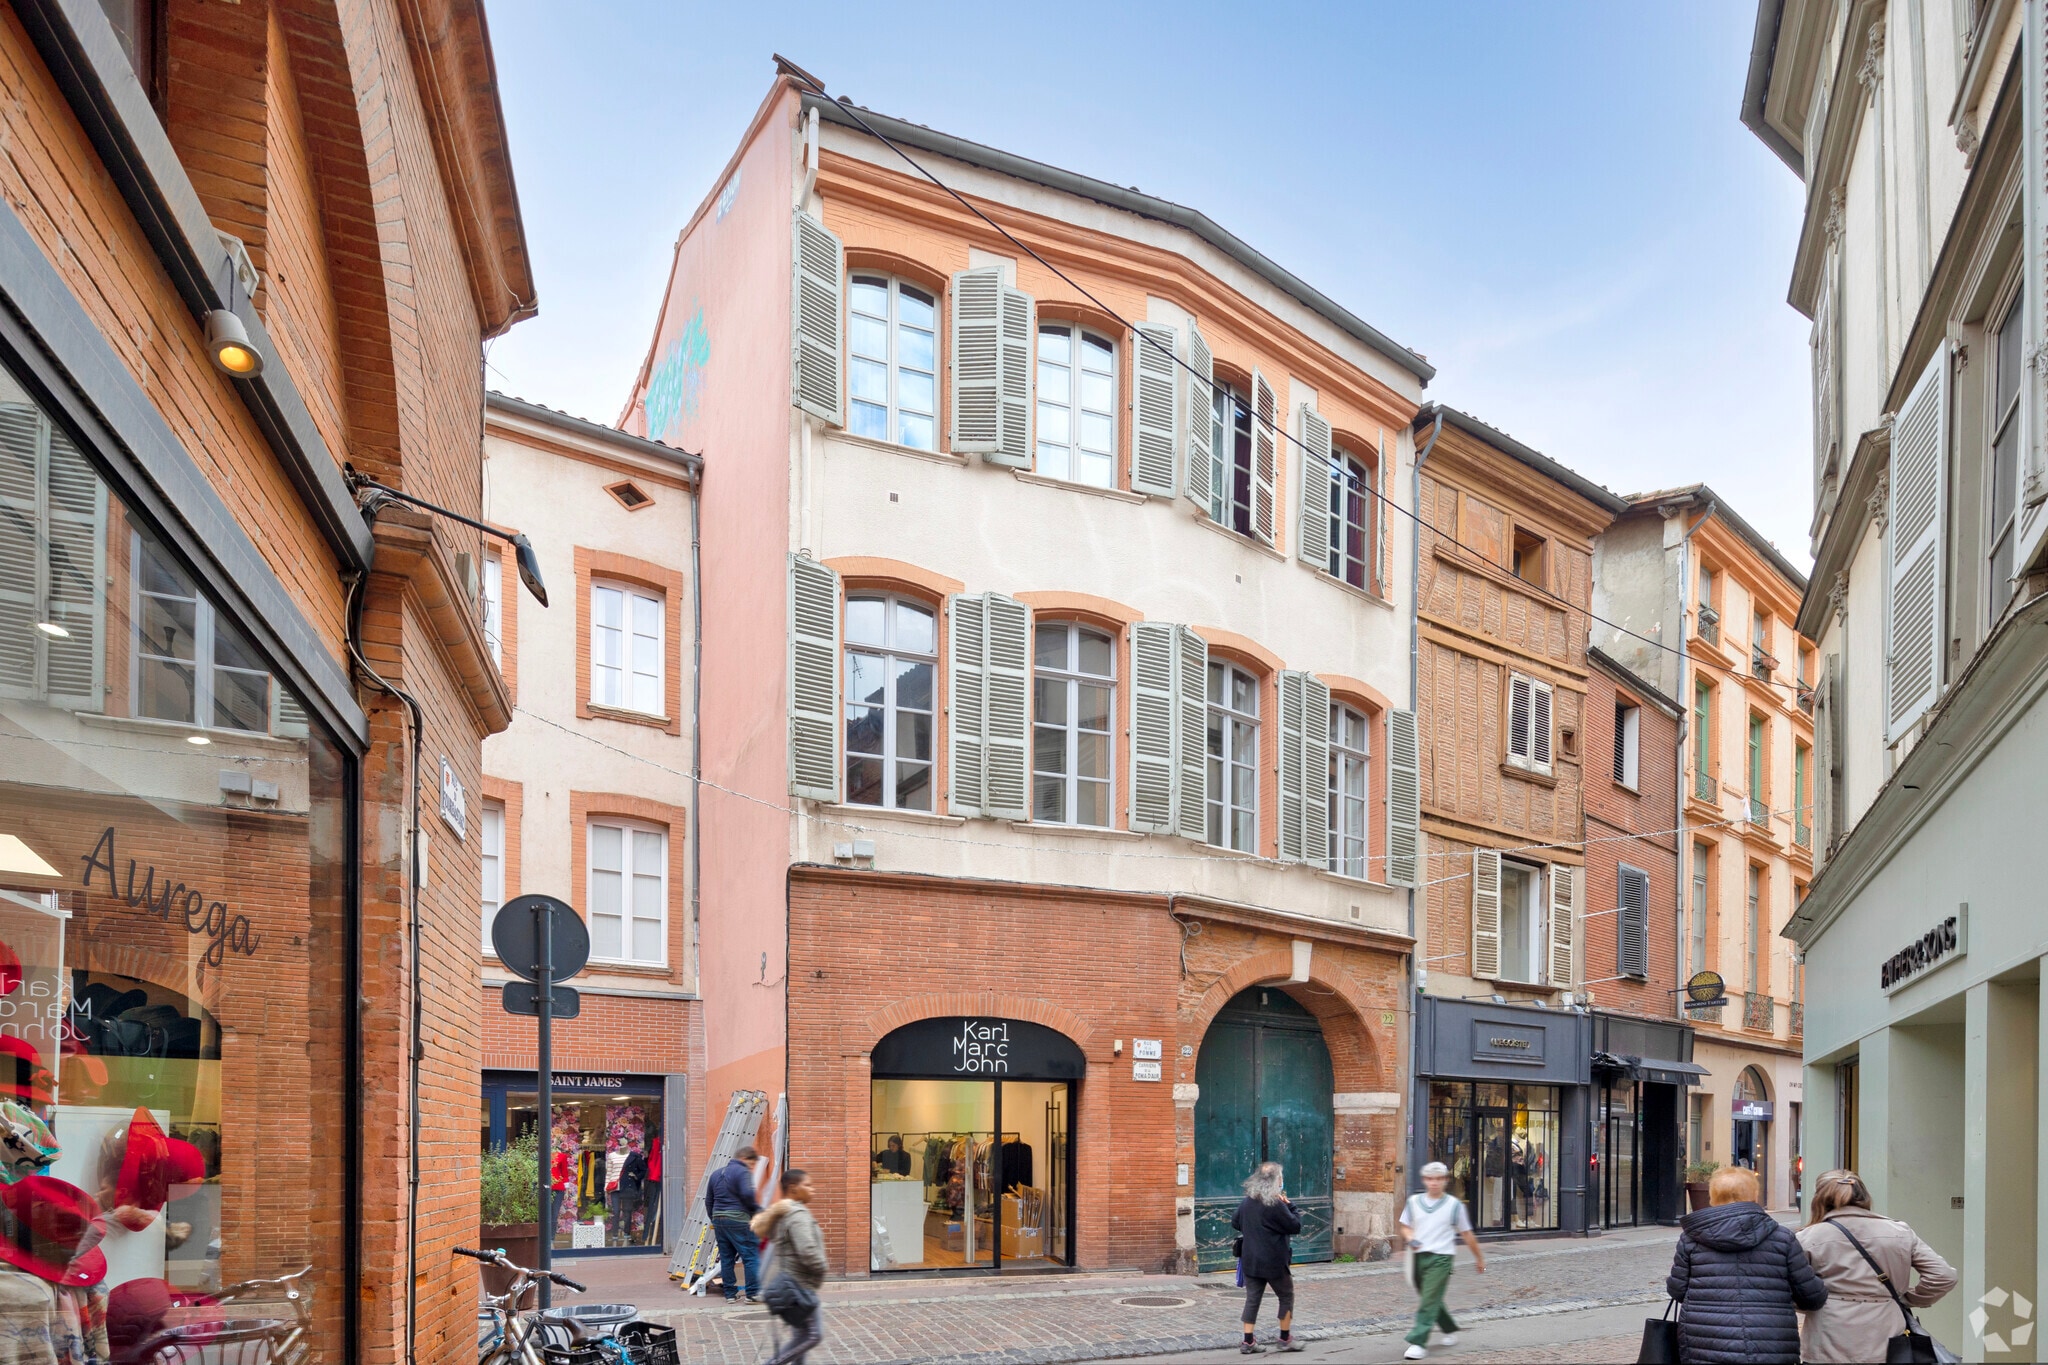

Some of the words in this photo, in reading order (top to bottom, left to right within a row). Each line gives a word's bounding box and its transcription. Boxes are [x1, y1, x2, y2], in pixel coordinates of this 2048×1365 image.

[81, 827, 261, 967] Aurega
[1383, 1013, 1394, 1024] 22
[965, 1021, 1010, 1041] Karl
[953, 1036, 1008, 1056] Marc
[1182, 1046, 1192, 1056] 22
[953, 1054, 1008, 1073] John
[584, 1076, 622, 1088] JAMES
